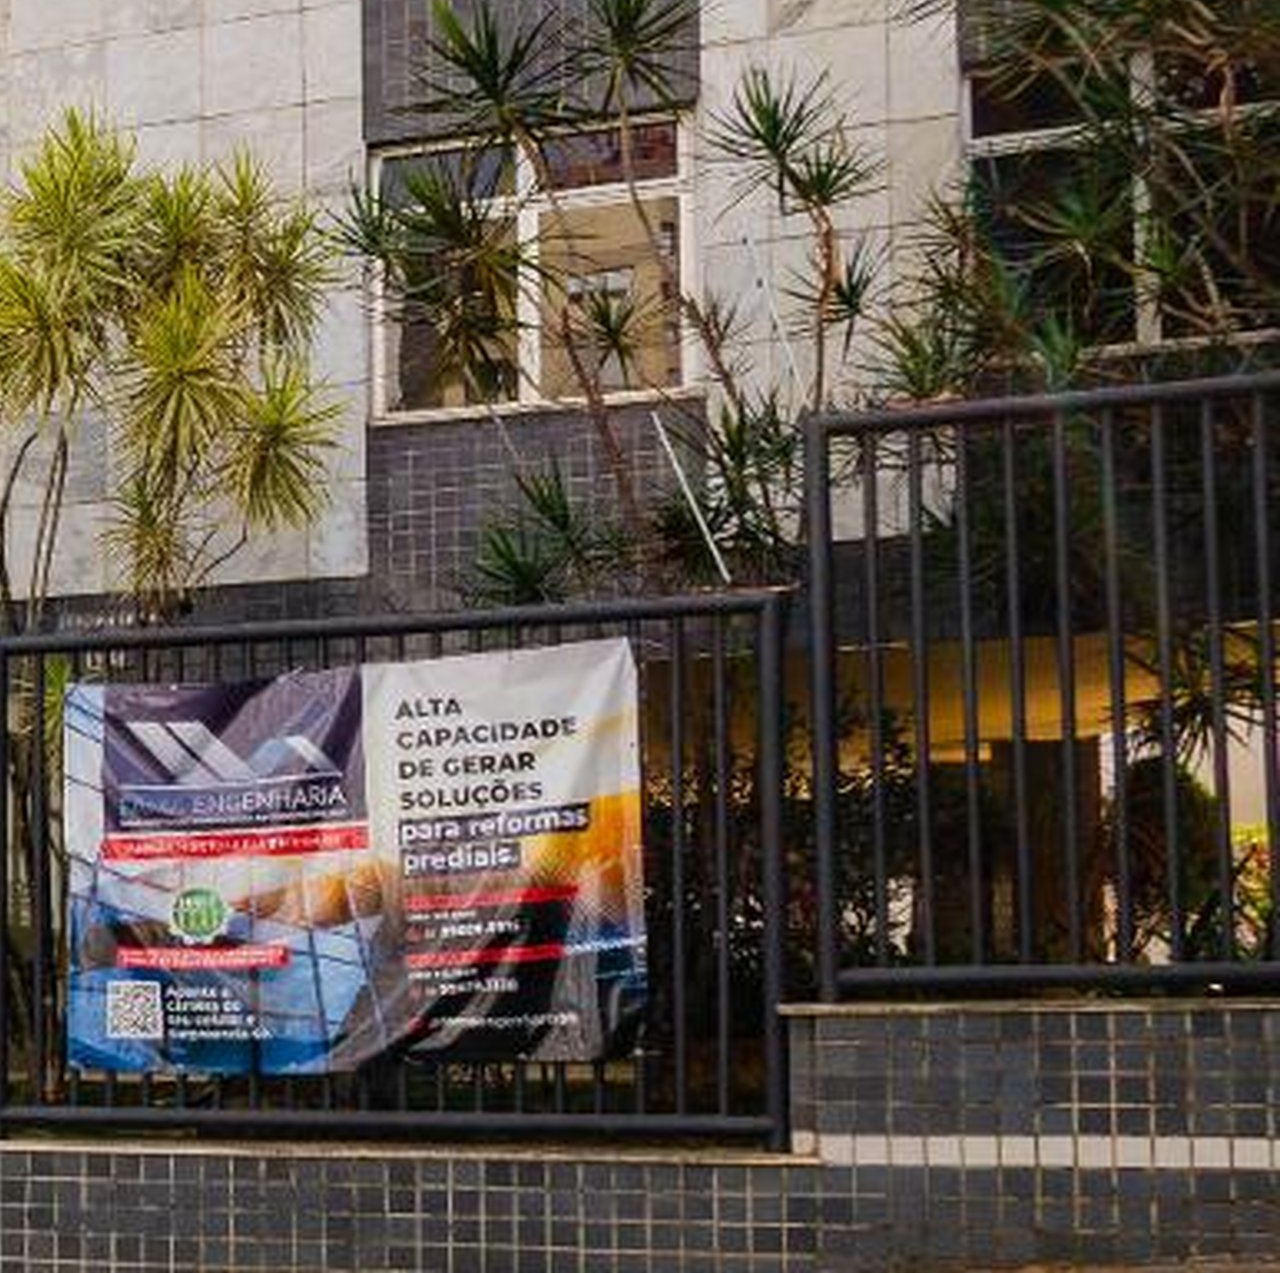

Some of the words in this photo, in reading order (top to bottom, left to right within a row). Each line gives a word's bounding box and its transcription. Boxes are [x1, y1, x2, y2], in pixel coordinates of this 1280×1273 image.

[395, 699, 462, 720] ALTA
[396, 716, 578, 750] CAPACIDADE
[398, 759, 434, 779] DE
[443, 752, 535, 777] GERAR
[193, 785, 348, 814] ENGENHARIA
[401, 779, 543, 810] SOLUÇÕES
[401, 821, 460, 845] para
[470, 806, 587, 837] reformas
